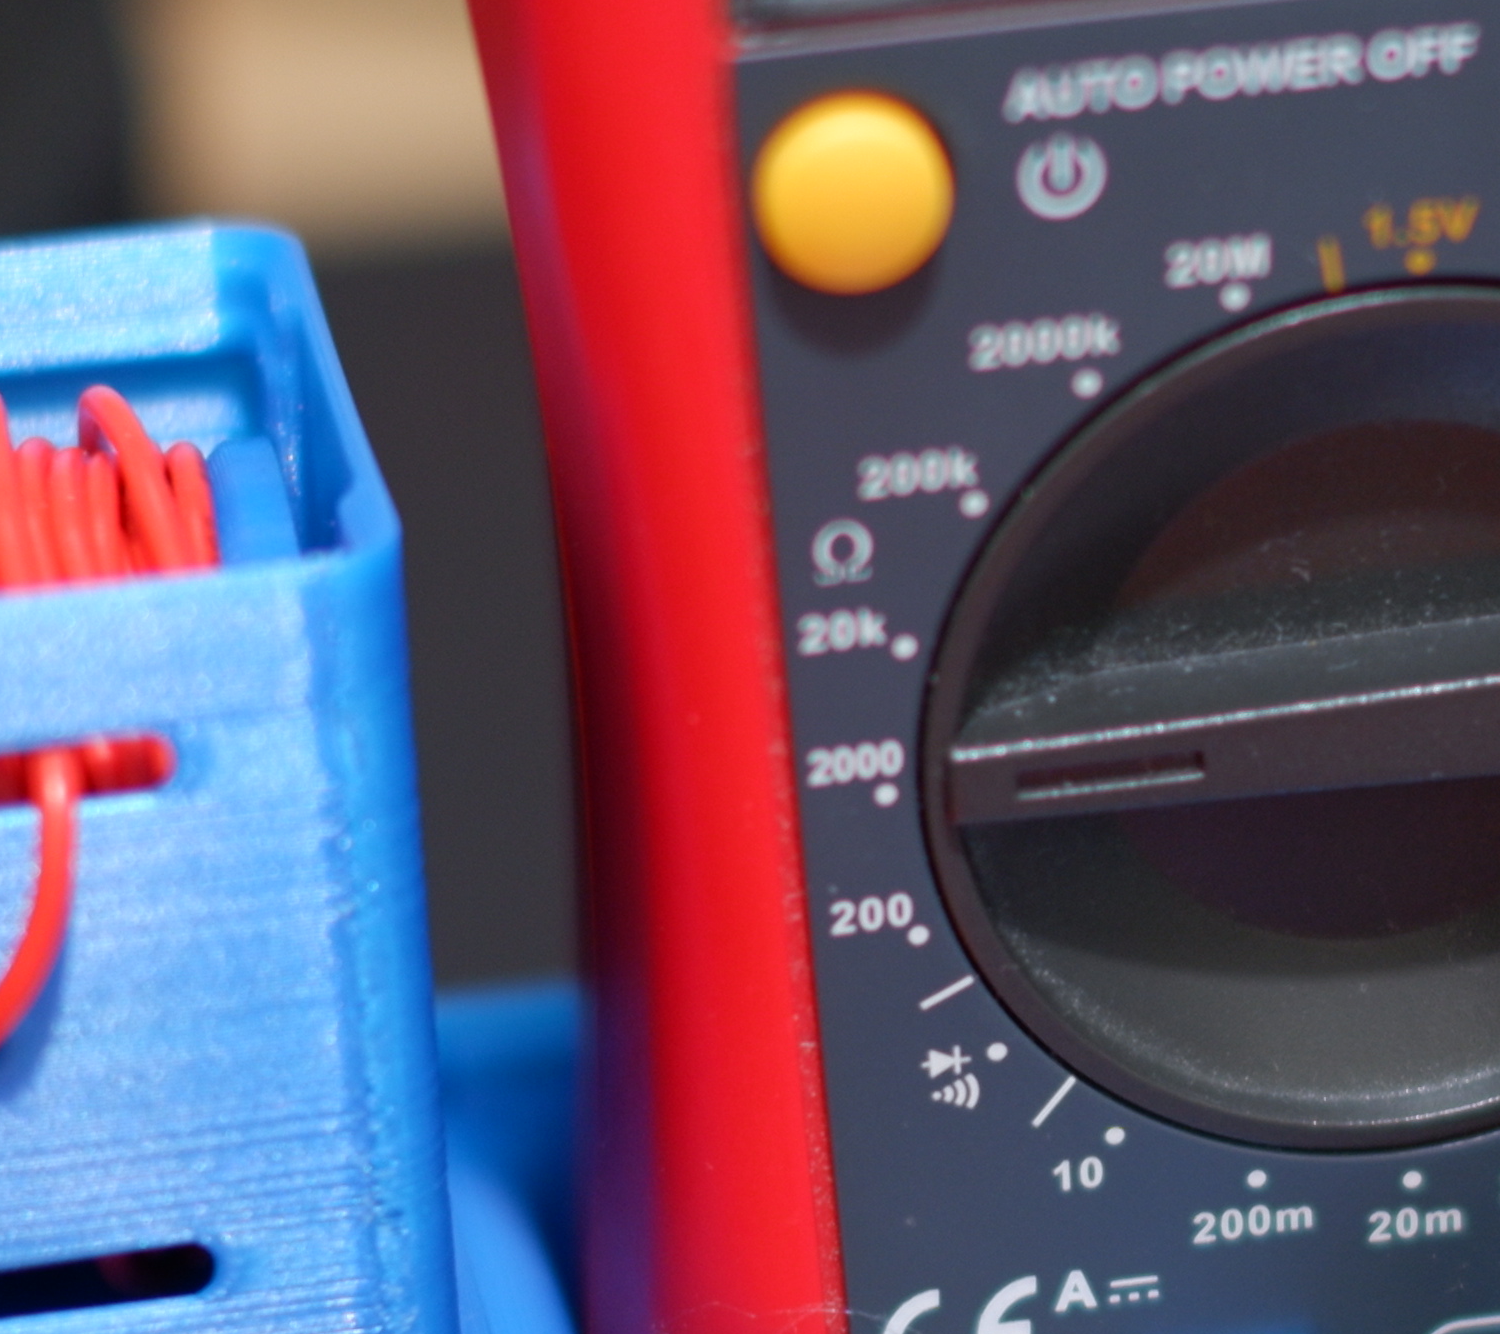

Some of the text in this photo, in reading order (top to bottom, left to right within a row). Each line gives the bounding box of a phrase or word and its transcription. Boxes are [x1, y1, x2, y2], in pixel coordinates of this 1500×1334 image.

[1004, 21, 1481, 123] AUTO POWER OFF
[1364, 196, 1481, 249] 1.5V
[968, 313, 1122, 371] 2000k
[856, 447, 978, 501] 200k
[798, 607, 887, 656] 20k
[806, 738, 905, 787] 2000
[829, 892, 914, 937] 200
[1052, 1156, 1104, 1193] 10
[1192, 1204, 1314, 1246] 200m
[1367, 1206, 1463, 1244] 20m
